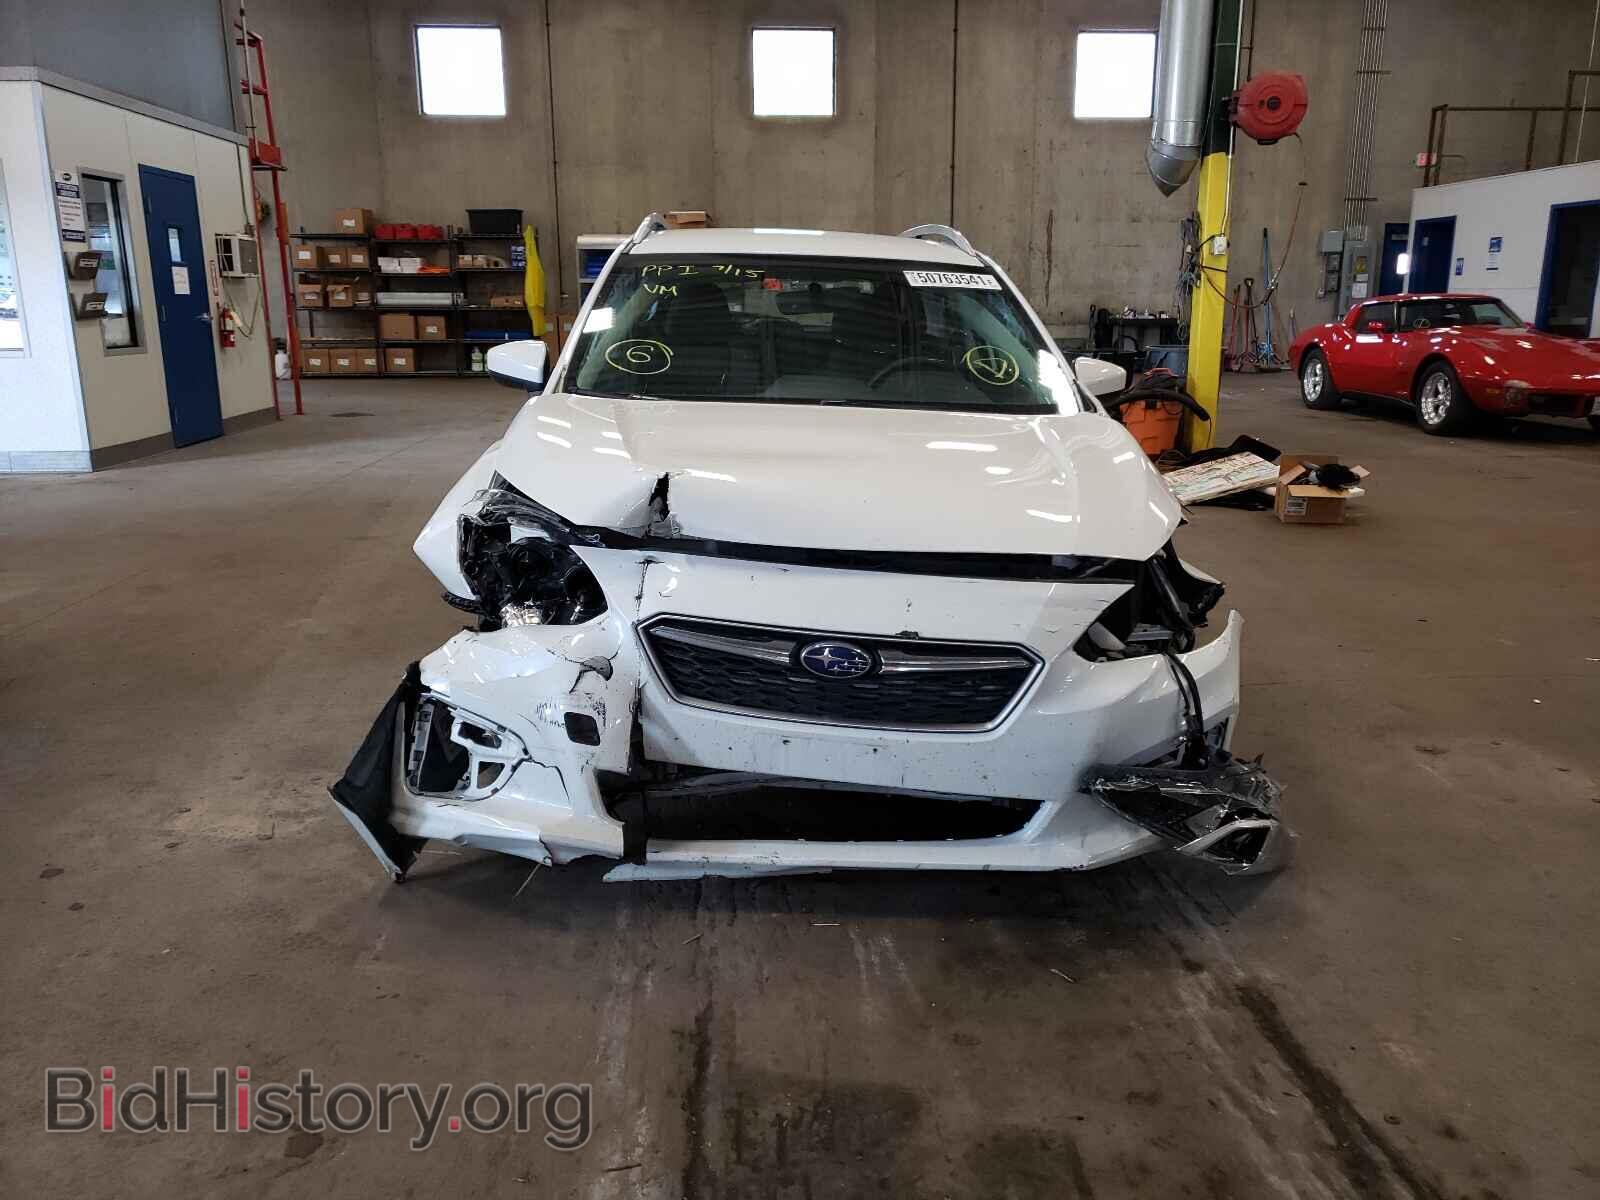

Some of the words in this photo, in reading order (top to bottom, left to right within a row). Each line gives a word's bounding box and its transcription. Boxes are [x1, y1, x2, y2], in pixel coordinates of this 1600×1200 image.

[711, 264, 765, 278] 7/15
[917, 272, 987, 286] 50763541
[643, 283, 678, 297] VM
